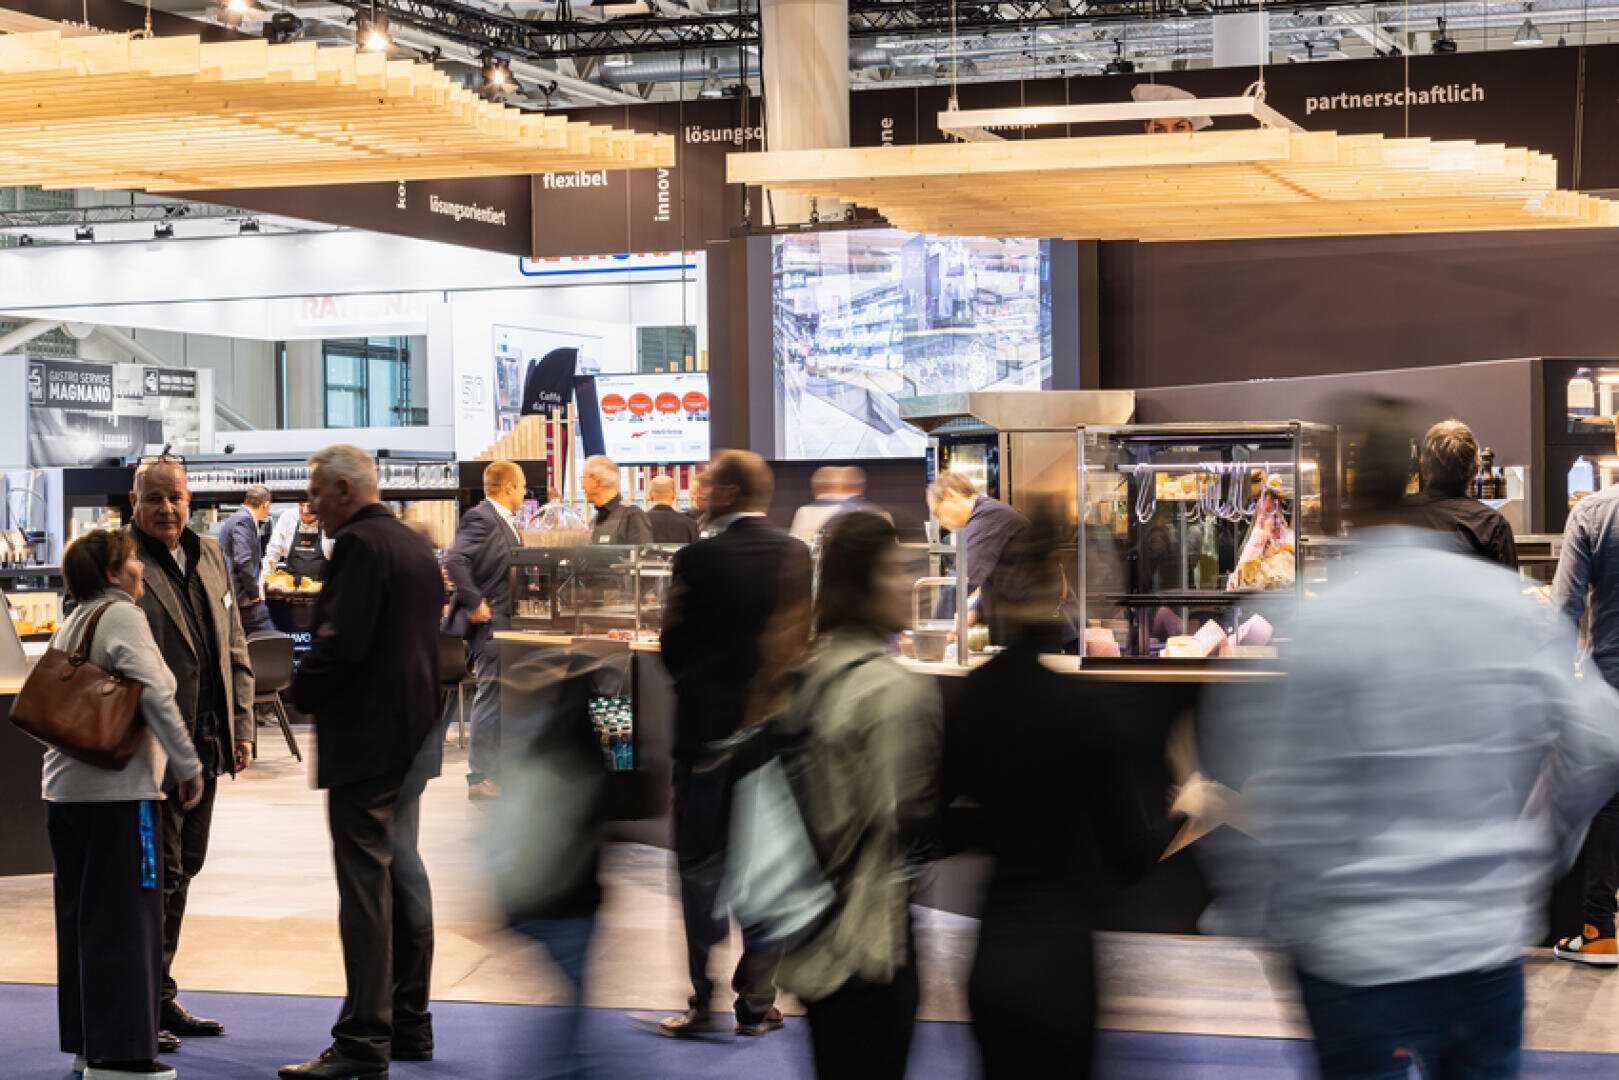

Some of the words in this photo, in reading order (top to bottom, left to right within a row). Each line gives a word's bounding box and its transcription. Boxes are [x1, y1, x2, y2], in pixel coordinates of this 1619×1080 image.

[1306, 83, 1485, 115] partnerschaftlich
[881, 117, 894, 147] ne
[543, 169, 608, 190] flexibel
[429, 193, 506, 226] lösungsorientiert
[49, 370, 78, 383] GASTRO
[80, 372, 111, 386] SERVICE
[49, 382, 111, 403] MAGNANO
